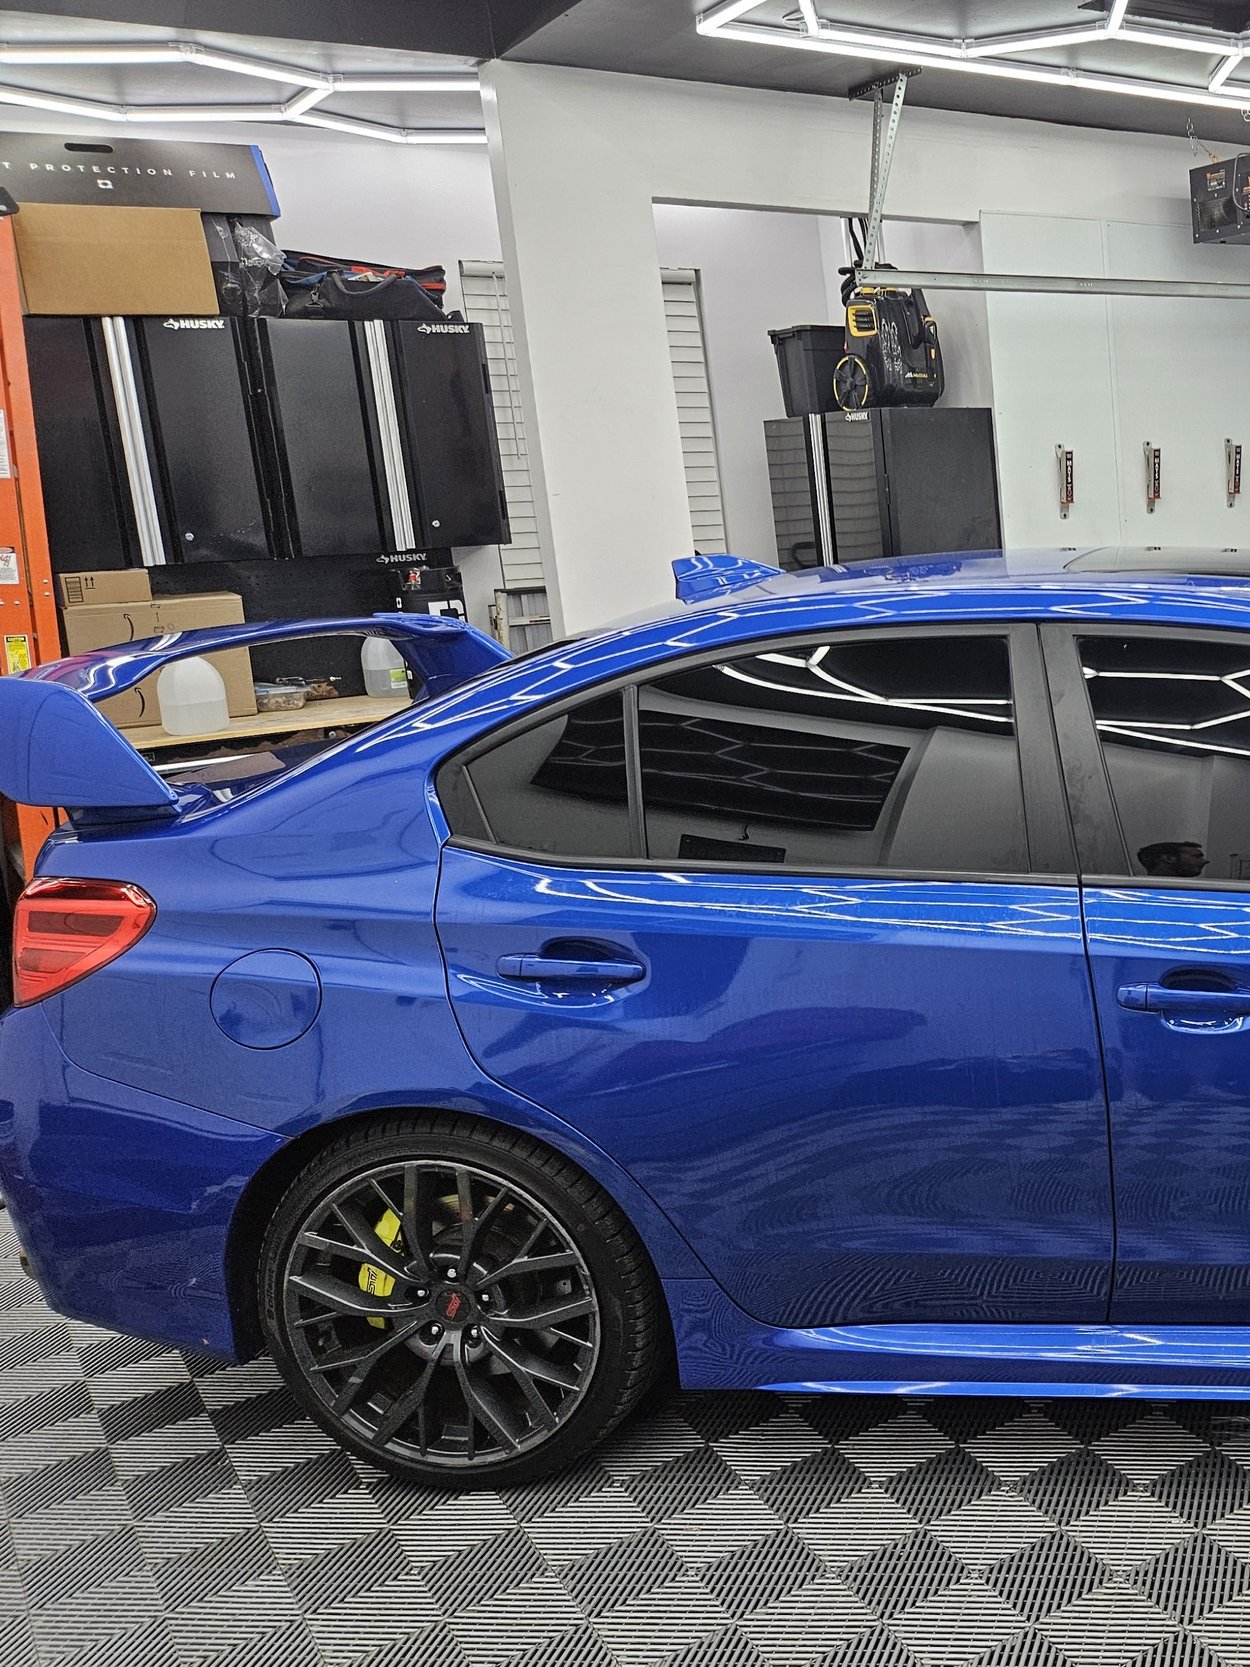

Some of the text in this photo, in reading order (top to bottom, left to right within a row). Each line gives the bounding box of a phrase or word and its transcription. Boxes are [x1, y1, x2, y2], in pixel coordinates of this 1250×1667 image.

[29, 162, 174, 177] PROTECTION
[188, 169, 237, 180] FILM
[180, 319, 225, 330] HUSKY
[431, 323, 470, 334] HUSKY
[389, 552, 427, 563] HUSKY
